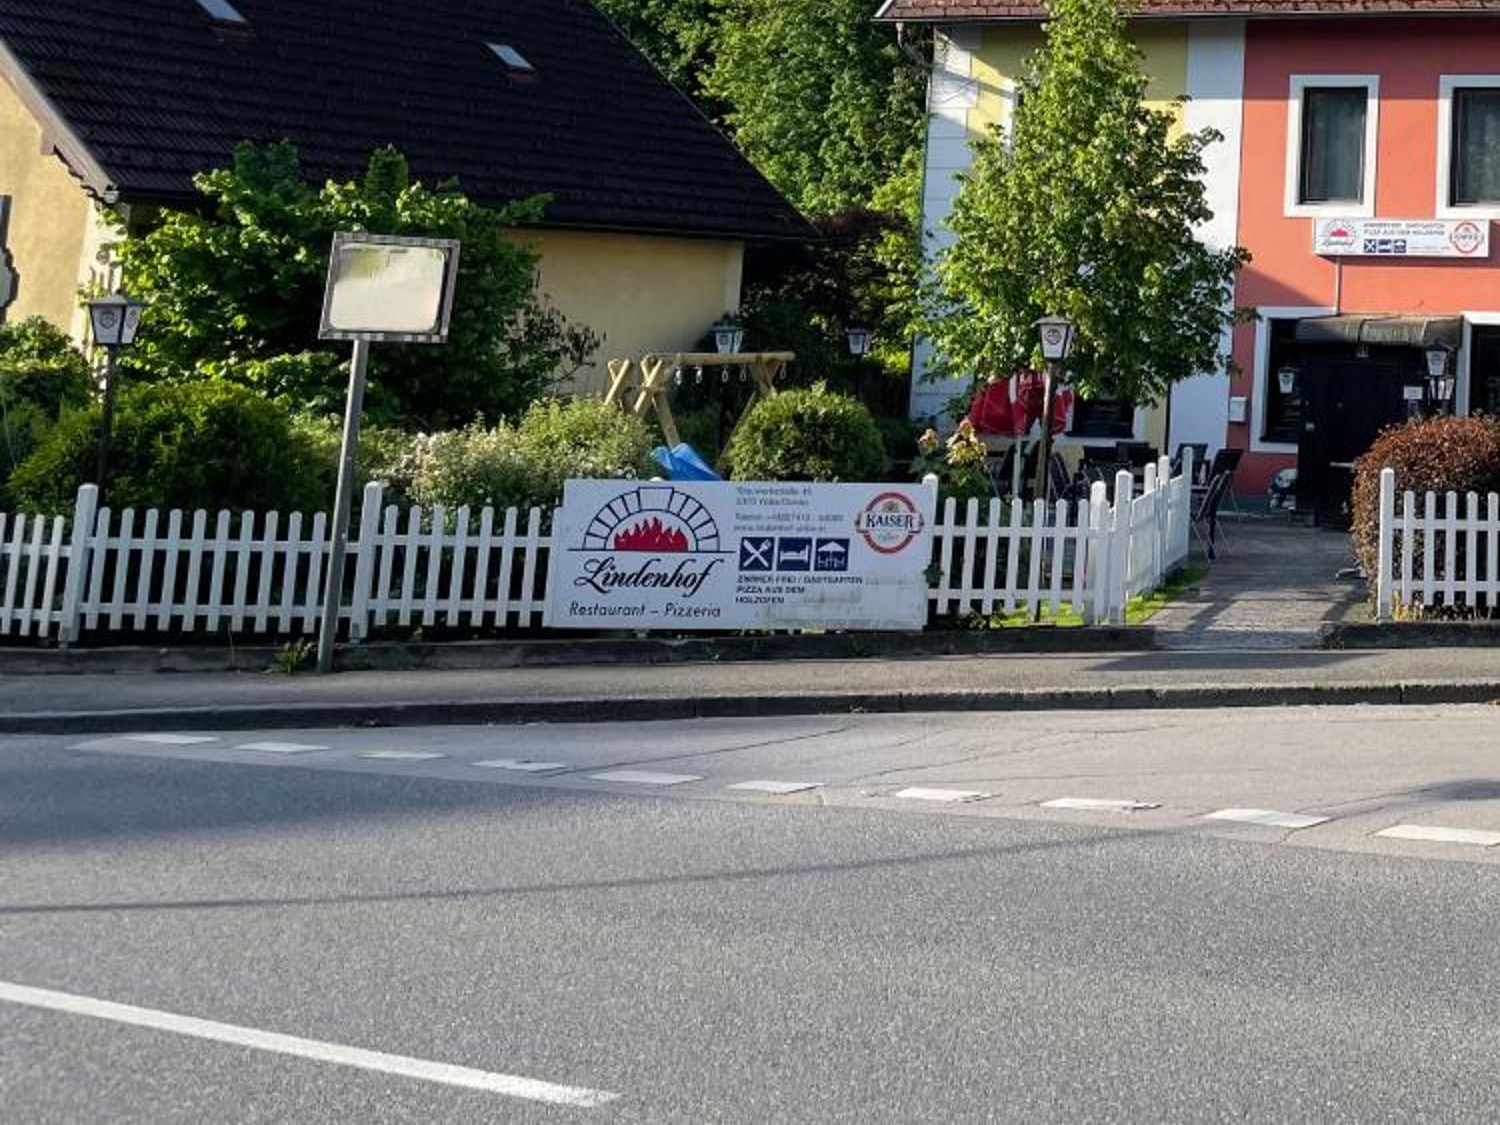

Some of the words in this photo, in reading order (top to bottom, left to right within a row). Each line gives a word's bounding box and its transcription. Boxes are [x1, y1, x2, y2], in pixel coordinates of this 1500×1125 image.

[865, 514, 914, 528] KAISER
[573, 557, 725, 598] Lindenhof
[737, 586, 763, 594] PIZZA
[764, 586, 783, 594] AUS
[785, 586, 806, 594] DEM
[735, 596, 785, 604] HOLZOFEN
[569, 601, 645, 617] Restaurant
[664, 602, 721, 618] Pizzeria
